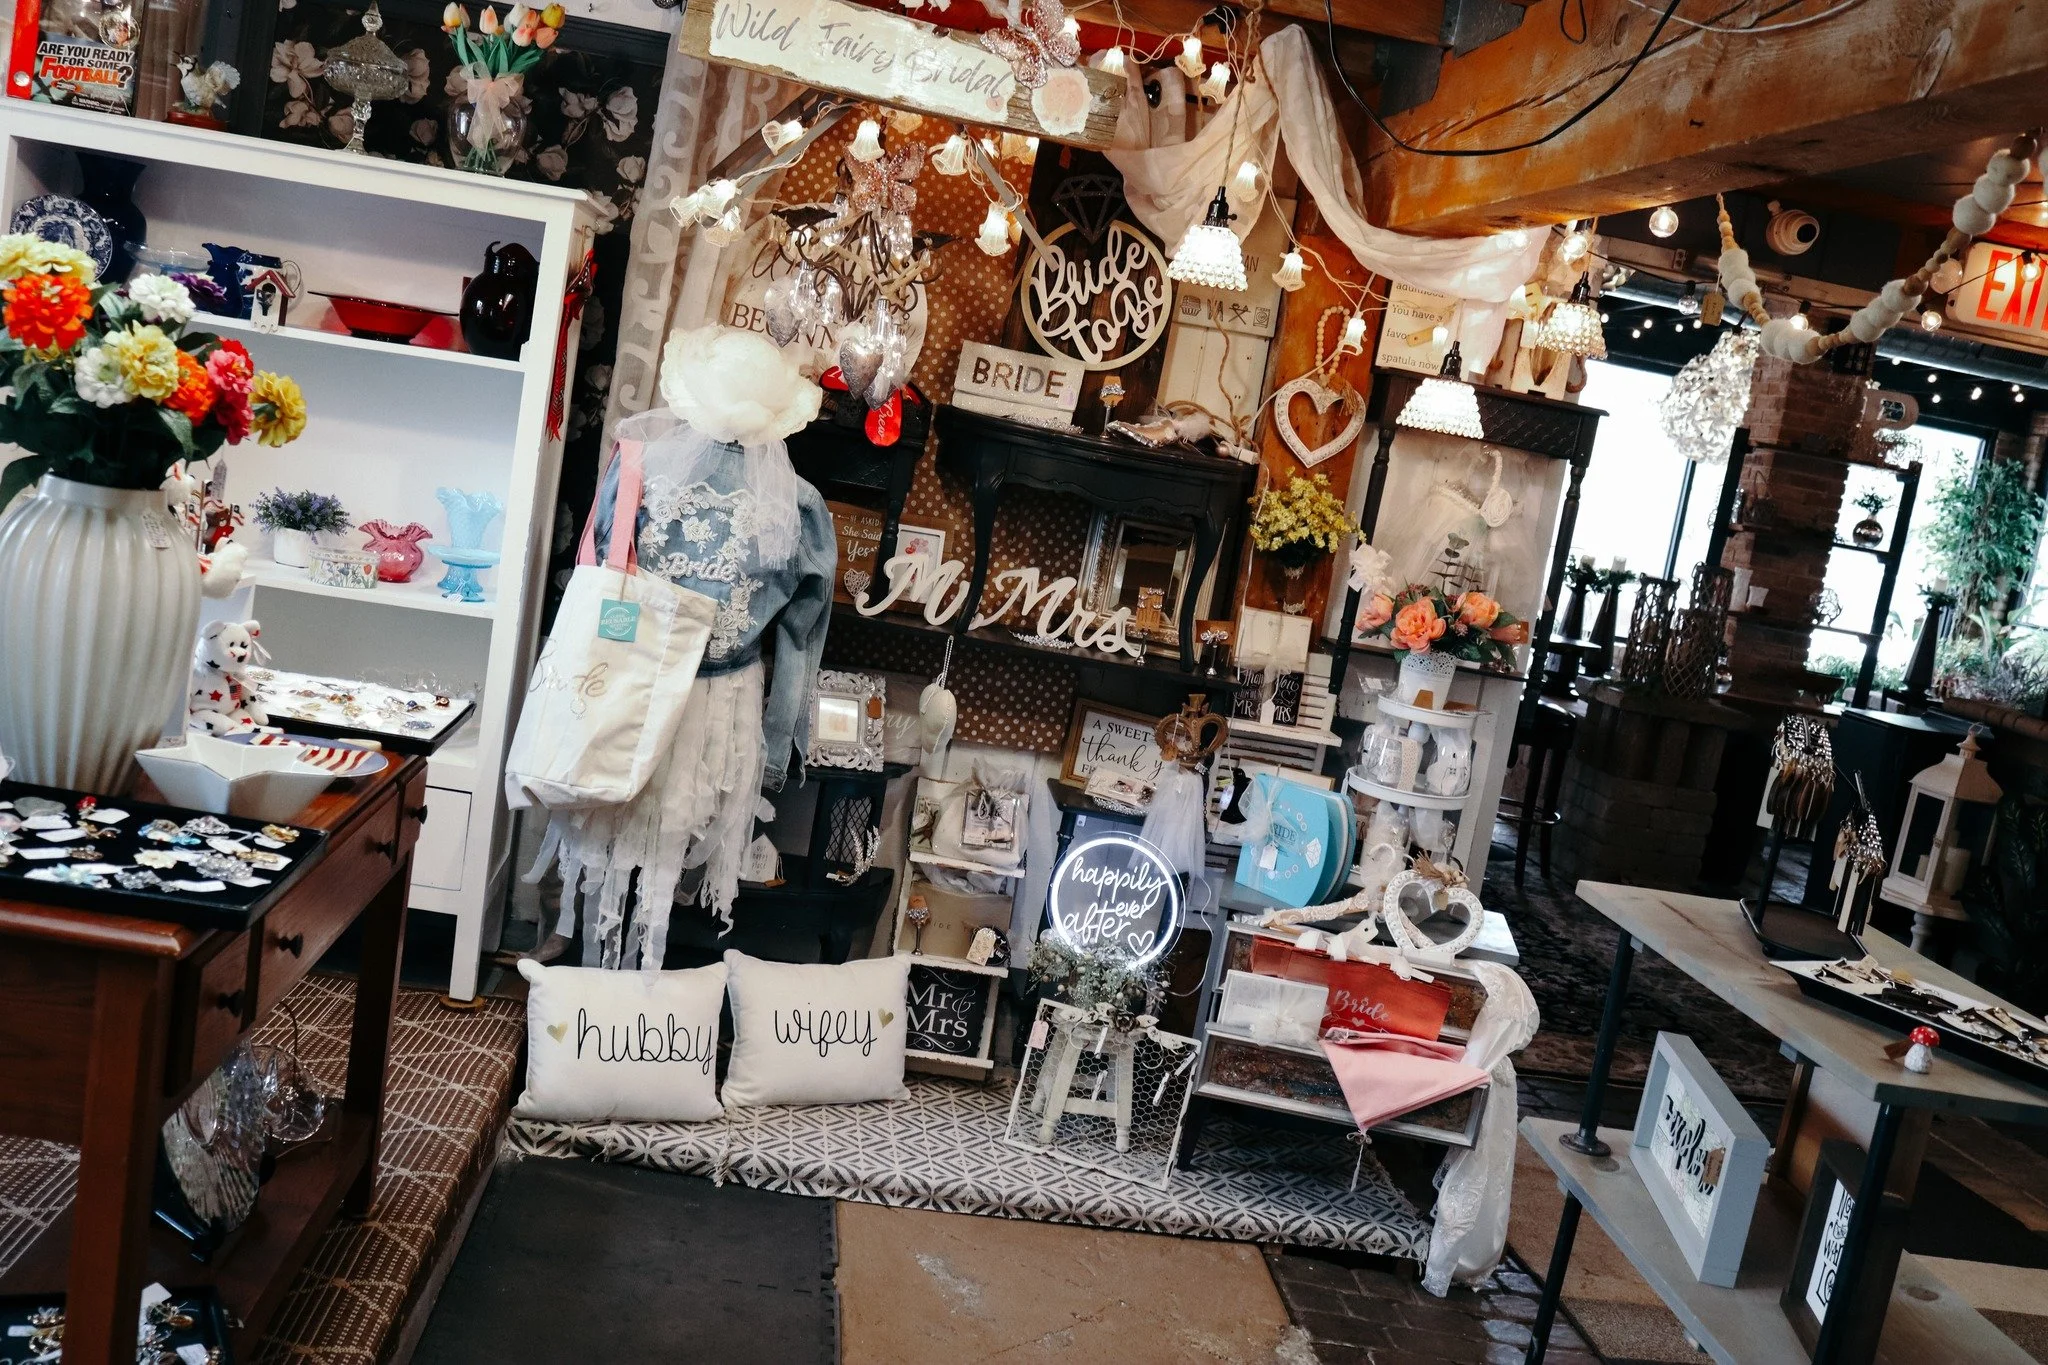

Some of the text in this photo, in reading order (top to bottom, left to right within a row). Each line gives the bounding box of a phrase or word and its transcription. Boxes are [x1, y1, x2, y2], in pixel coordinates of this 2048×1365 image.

[39, 42, 134, 63] ARE YOU READY
[61, 56, 120, 70] FOR SOME
[715, 0, 1013, 99] Wild Fairy Bridal
[1029, 225, 1150, 338] Bride
[1392, 304, 1410, 317] You
[1411, 309, 1436, 321] have
[1061, 310, 1122, 365] to
[1381, 353, 1417, 368] spatula
[971, 356, 1067, 399] BRIDE
[841, 525, 860, 538] She
[667, 551, 738, 584] Bride
[846, 539, 872, 563] Yes
[967, 566, 1148, 659] Mrs
[1240, 667, 1266, 688] Than
[1092, 719, 1152, 743] A SWEET
[1081, 732, 1147, 773] thank
[1274, 823, 1297, 844] RIDE
[1071, 855, 1165, 911] happily
[1062, 900, 1132, 944] after
[1114, 899, 1152, 920] ever
[906, 981, 954, 1011] Mr
[1333, 989, 1391, 1023] Bride
[774, 1002, 879, 1058] wifey
[906, 1005, 969, 1038] Mrs
[576, 1007, 715, 1076] hubby
